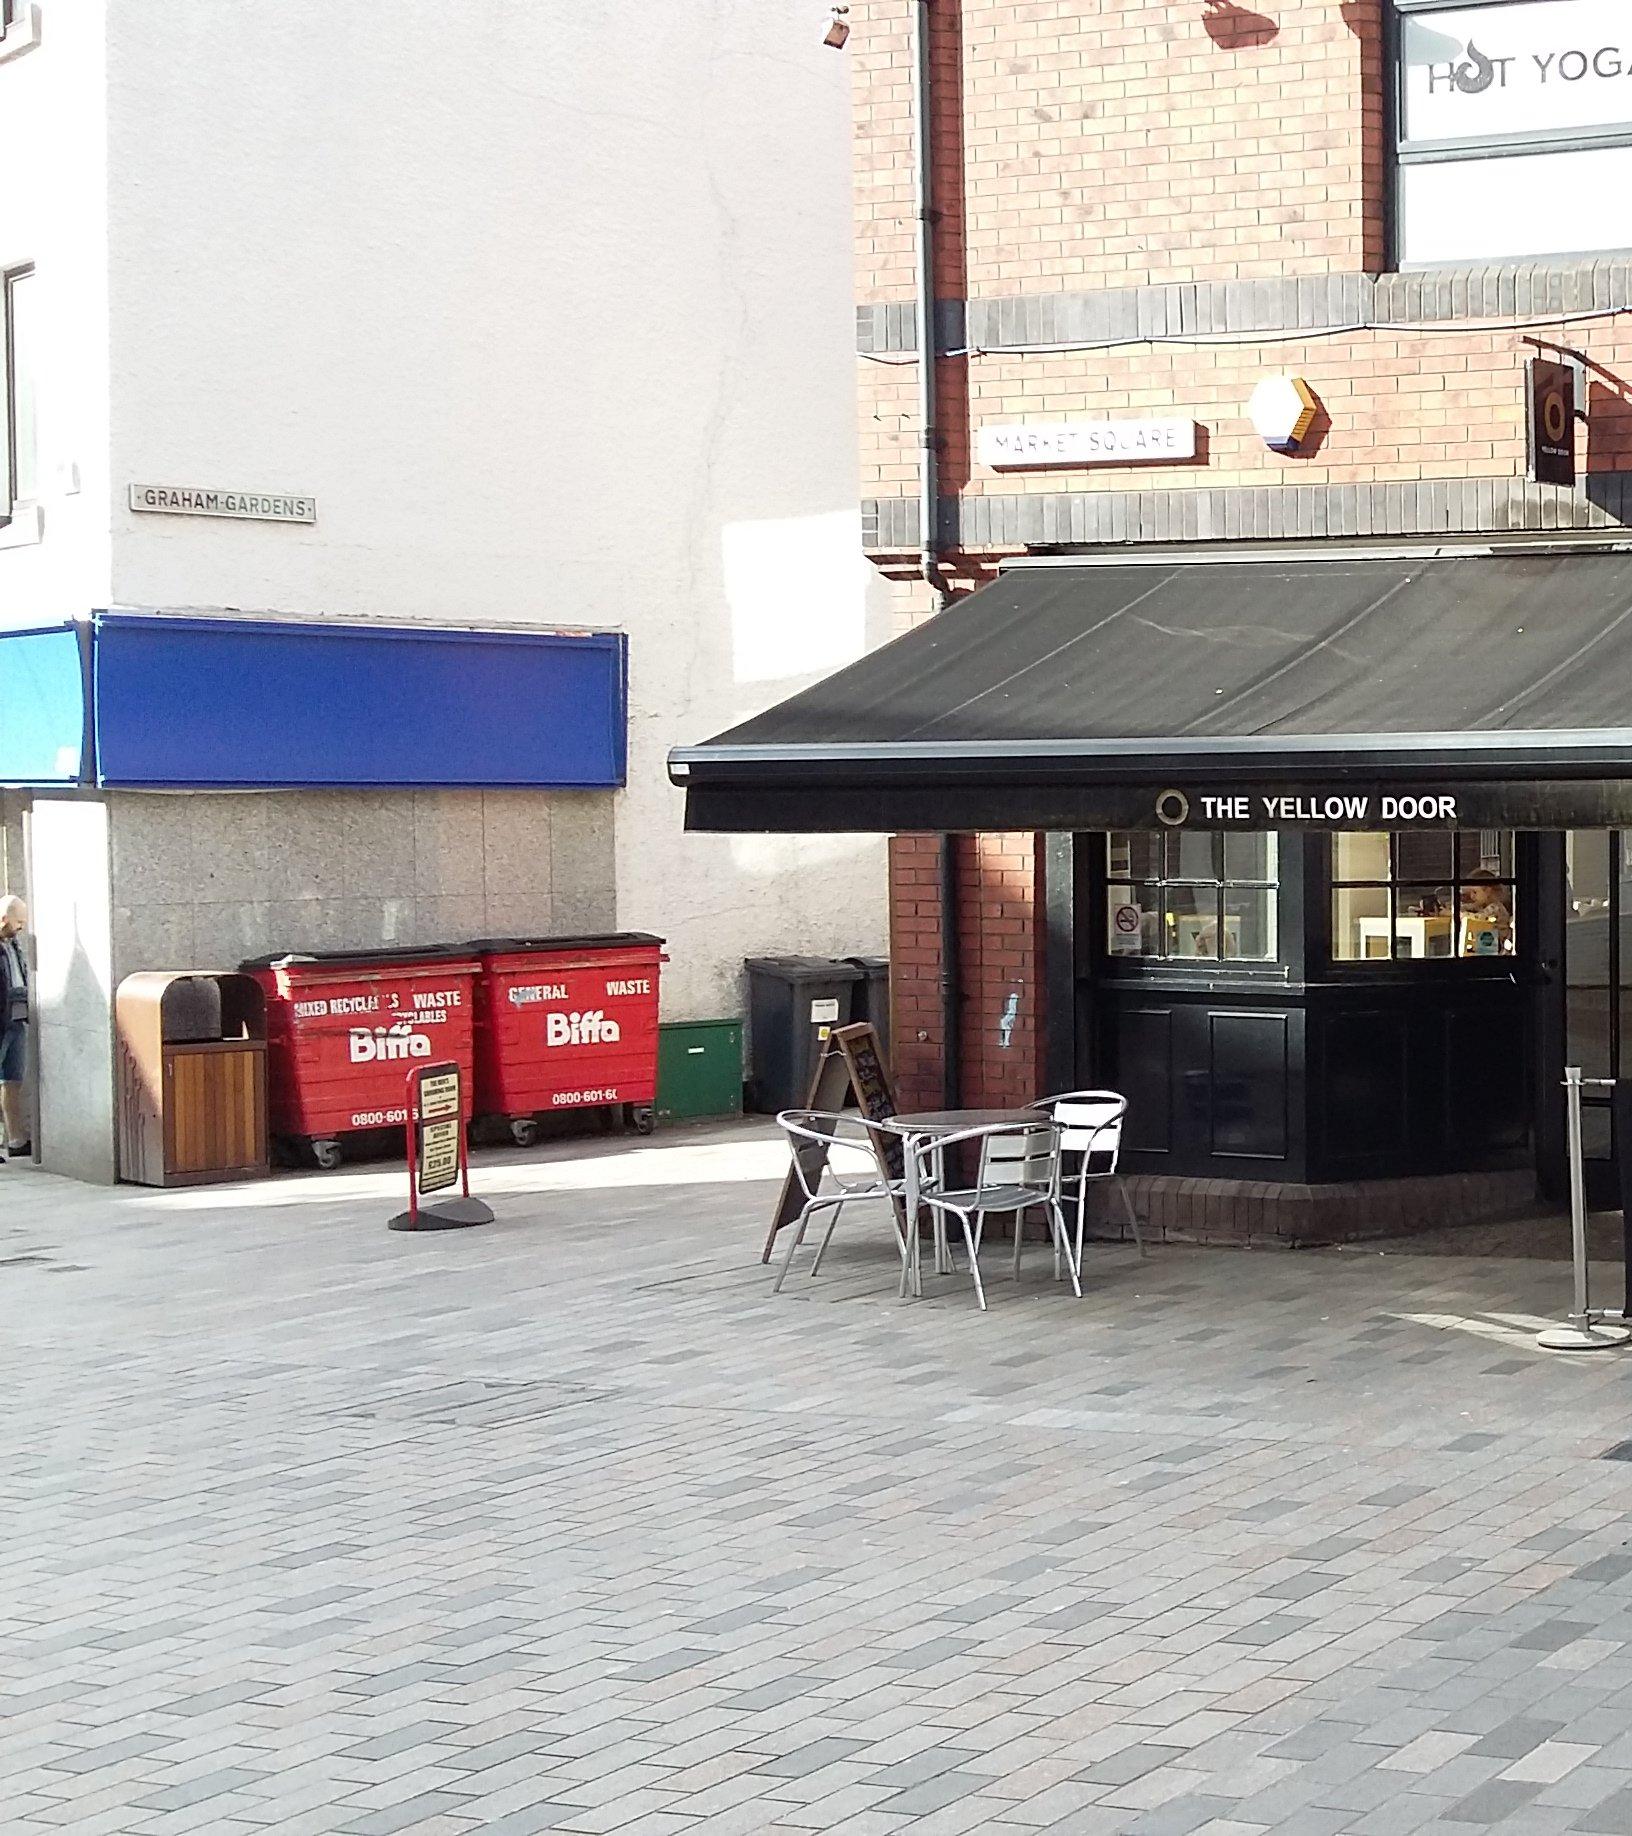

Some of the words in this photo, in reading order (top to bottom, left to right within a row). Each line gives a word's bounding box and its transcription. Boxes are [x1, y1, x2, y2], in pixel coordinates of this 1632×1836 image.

[1428, 37, 1516, 94] HOT
[995, 433, 1077, 453] MARET
[1200, 796, 1250, 819] THE
[1262, 796, 1369, 820] YELLOW
[1381, 796, 1457, 820] DOOR
[606, 979, 650, 996] WASTE
[329, 992, 399, 1014] RECYCLAS
[412, 991, 462, 1009] WASTE
[546, 1010, 621, 1047] Biffa
[349, 1024, 432, 1063] Biffa
